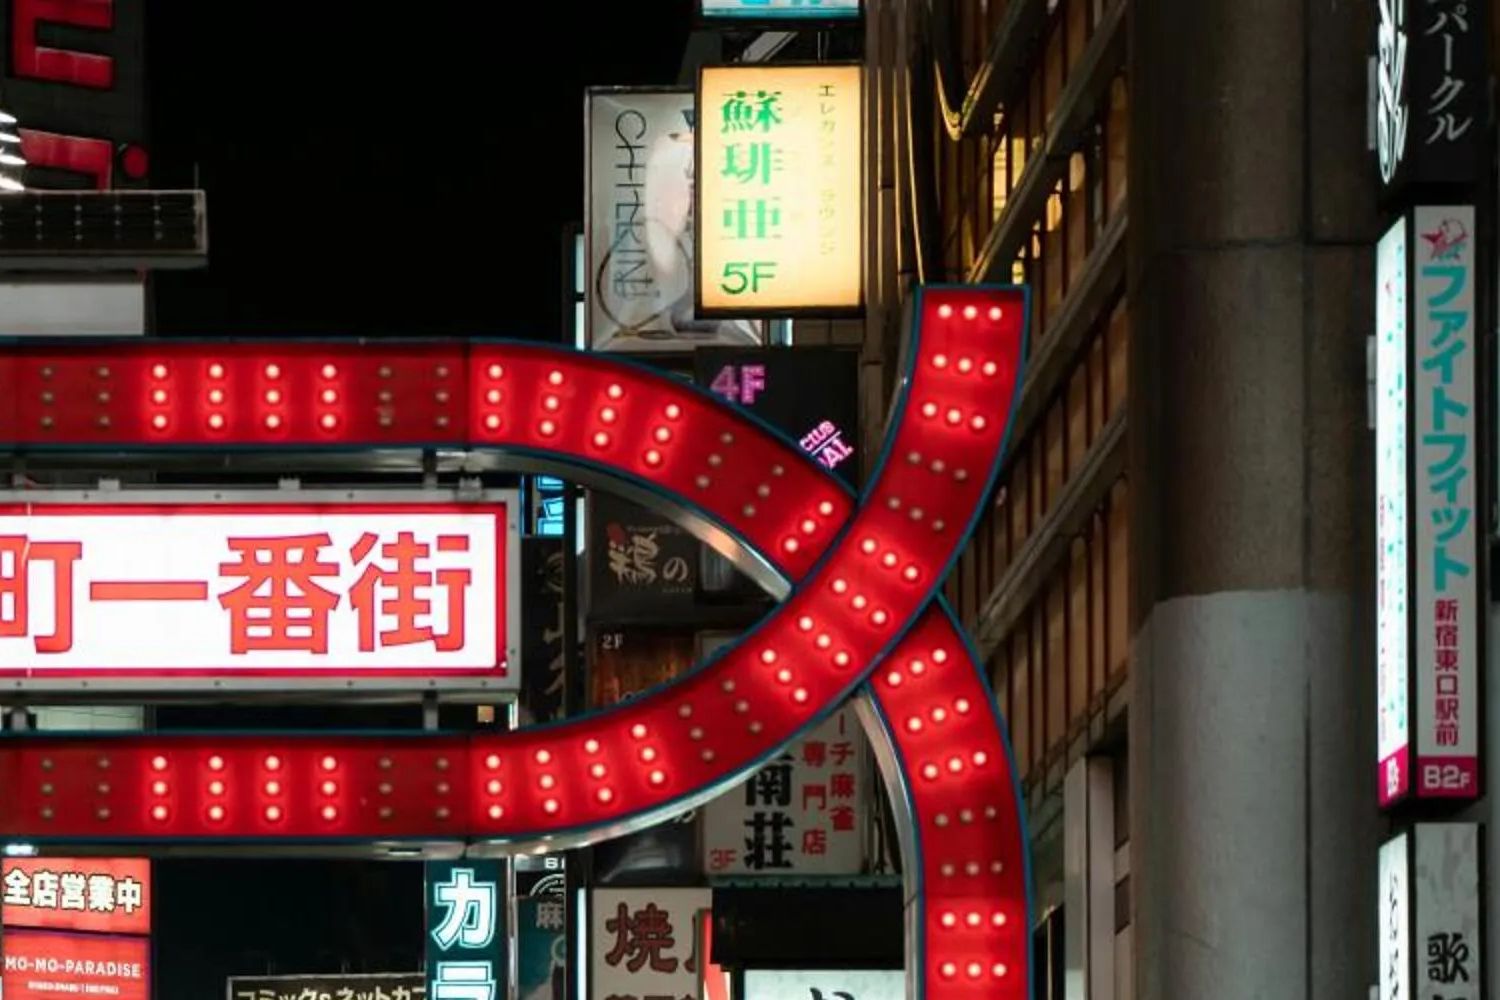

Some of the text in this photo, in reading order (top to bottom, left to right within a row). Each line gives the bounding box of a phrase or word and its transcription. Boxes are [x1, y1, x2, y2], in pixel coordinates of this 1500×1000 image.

[720, 262, 778, 295] 5F
[710, 364, 766, 405] 4F
[1420, 265, 1473, 594] ファイトフィット
[1434, 599, 1460, 747] 新宿東口駅前
[802, 741, 828, 855] 専門店
[829, 712, 855, 833] ーチ麻雀
[1423, 763, 1472, 790] B2F
[3, 866, 143, 914] 全店営業中
[4, 956, 142, 979] MO-MO-PARADISE
[605, 902, 699, 974] 焼
